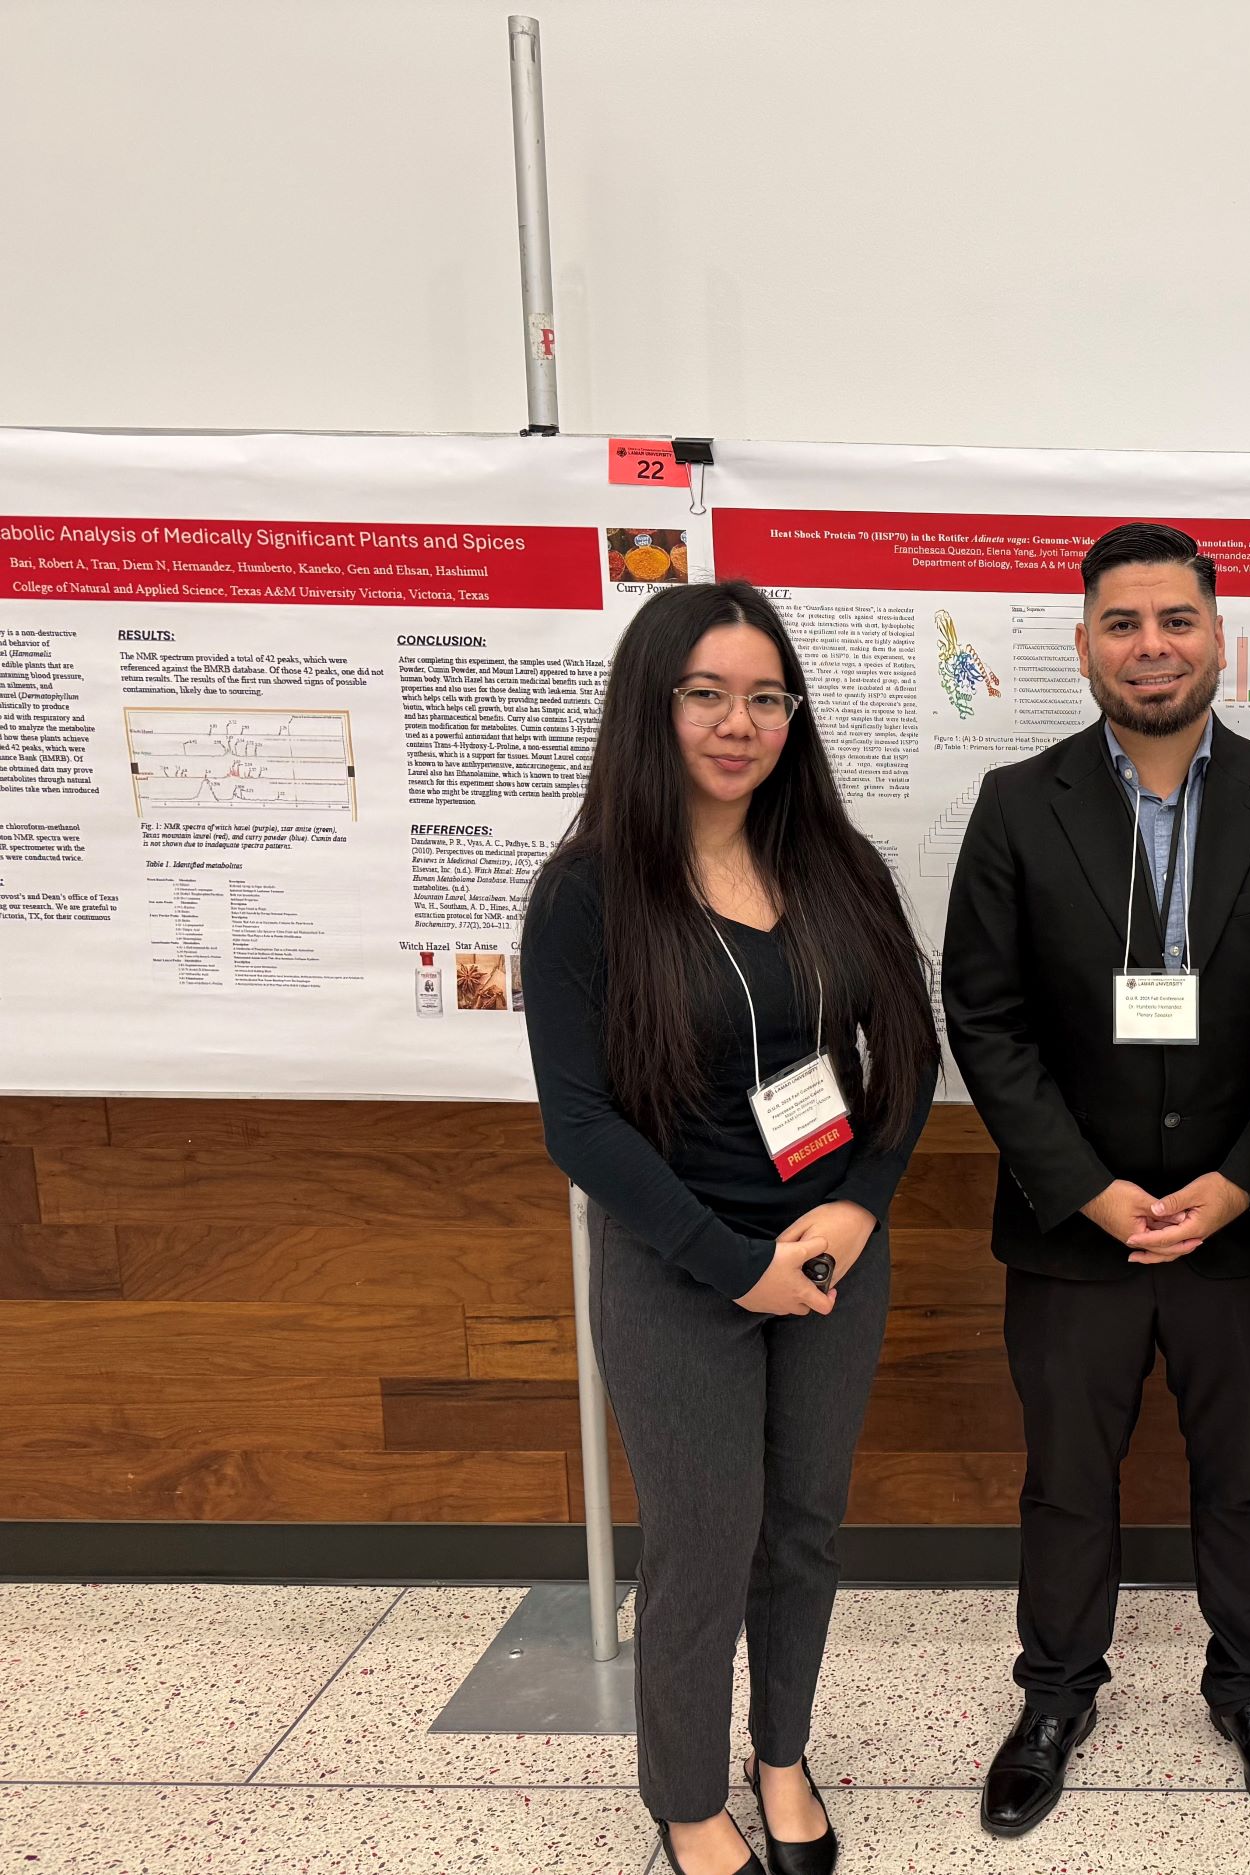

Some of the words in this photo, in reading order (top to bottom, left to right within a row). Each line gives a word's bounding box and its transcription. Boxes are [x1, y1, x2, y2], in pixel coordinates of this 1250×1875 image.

[638, 460, 664, 480] 22
[0, 525, 54, 540] abolic
[60, 526, 136, 544] Analysis
[141, 527, 159, 542] of
[164, 528, 252, 547] Medically
[256, 529, 355, 548] Significant
[359, 531, 418, 547] Plants
[423, 533, 457, 548] and
[462, 533, 525, 551] Spices
[770, 529, 791, 537] Heat
[794, 530, 821, 538] Shock
[823, 530, 855, 539] Protein
[858, 531, 868, 539] 70
[871, 532, 908, 541] (HSP70)
[911, 533, 919, 541] in
[921, 533, 935, 541] the
[938, 533, 969, 542] Rotifer
[971, 534, 1004, 542] Adineta
[1007, 537, 1029, 545] vaga:
[894, 545, 945, 554] Franchesca
[947, 546, 984, 555] Quezon,
[986, 547, 1011, 555] Elena
[1013, 548, 1036, 557] Yang,
[1039, 549, 1057, 557] Jyoti
[9, 557, 35, 569] Bari,
[38, 558, 73, 568] Robert
[75, 559, 88, 570] A,
[90, 559, 120, 570] Tran,
[122, 559, 153, 570] Diem
[155, 560, 169, 571] N,
[172, 560, 234, 571] Hernandez,
[237, 562, 295, 573] Humberto,
[298, 563, 344, 574] Kaneko,
[347, 564, 370, 574] Gen
[373, 564, 393, 574] and
[395, 565, 432, 576] Ehsan,
[435, 565, 488, 576] Hashimul
[912, 558, 965, 566] Department
[967, 559, 976, 567] of
[978, 559, 1012, 569] Biology,
[1014, 560, 1038, 568] Texas
[1040, 560, 1047, 568] A
[1057, 561, 1065, 569] M
[1214, 564, 1240, 573] ilson,
[12, 581, 53, 594] College
[55, 581, 68, 592] of
[69, 582, 110, 593] Natural
[113, 583, 133, 593] and
[135, 584, 179, 596] Applied
[182, 584, 227, 595] Science,
[229, 585, 261, 595] Texas
[263, 586, 296, 596] A&M
[299, 586, 356, 599] University
[358, 588, 405, 599] Victoria,
[408, 589, 455, 600] Victoria,
[457, 589, 489, 600] Texas
[616, 583, 644, 594] Curry
[117, 629, 176, 643] RESULTS:
[397, 635, 487, 647] CONCLUSION:
[119, 651, 134, 659] The
[135, 652, 158, 660] NMR
[195, 653, 229, 662] provided
[236, 654, 253, 662] total
[255, 654, 264, 662] of
[265, 654, 275, 662] 42
[276, 655, 301, 664] peaks,
[302, 655, 327, 663] which
[411, 824, 493, 836] REFERENCES:
[399, 941, 424, 952] Witch
[426, 942, 450, 952] Hazel
[455, 941, 472, 949] Star
[473, 941, 497, 950] Anise
[787, 1129, 840, 1166] PRESENTER
